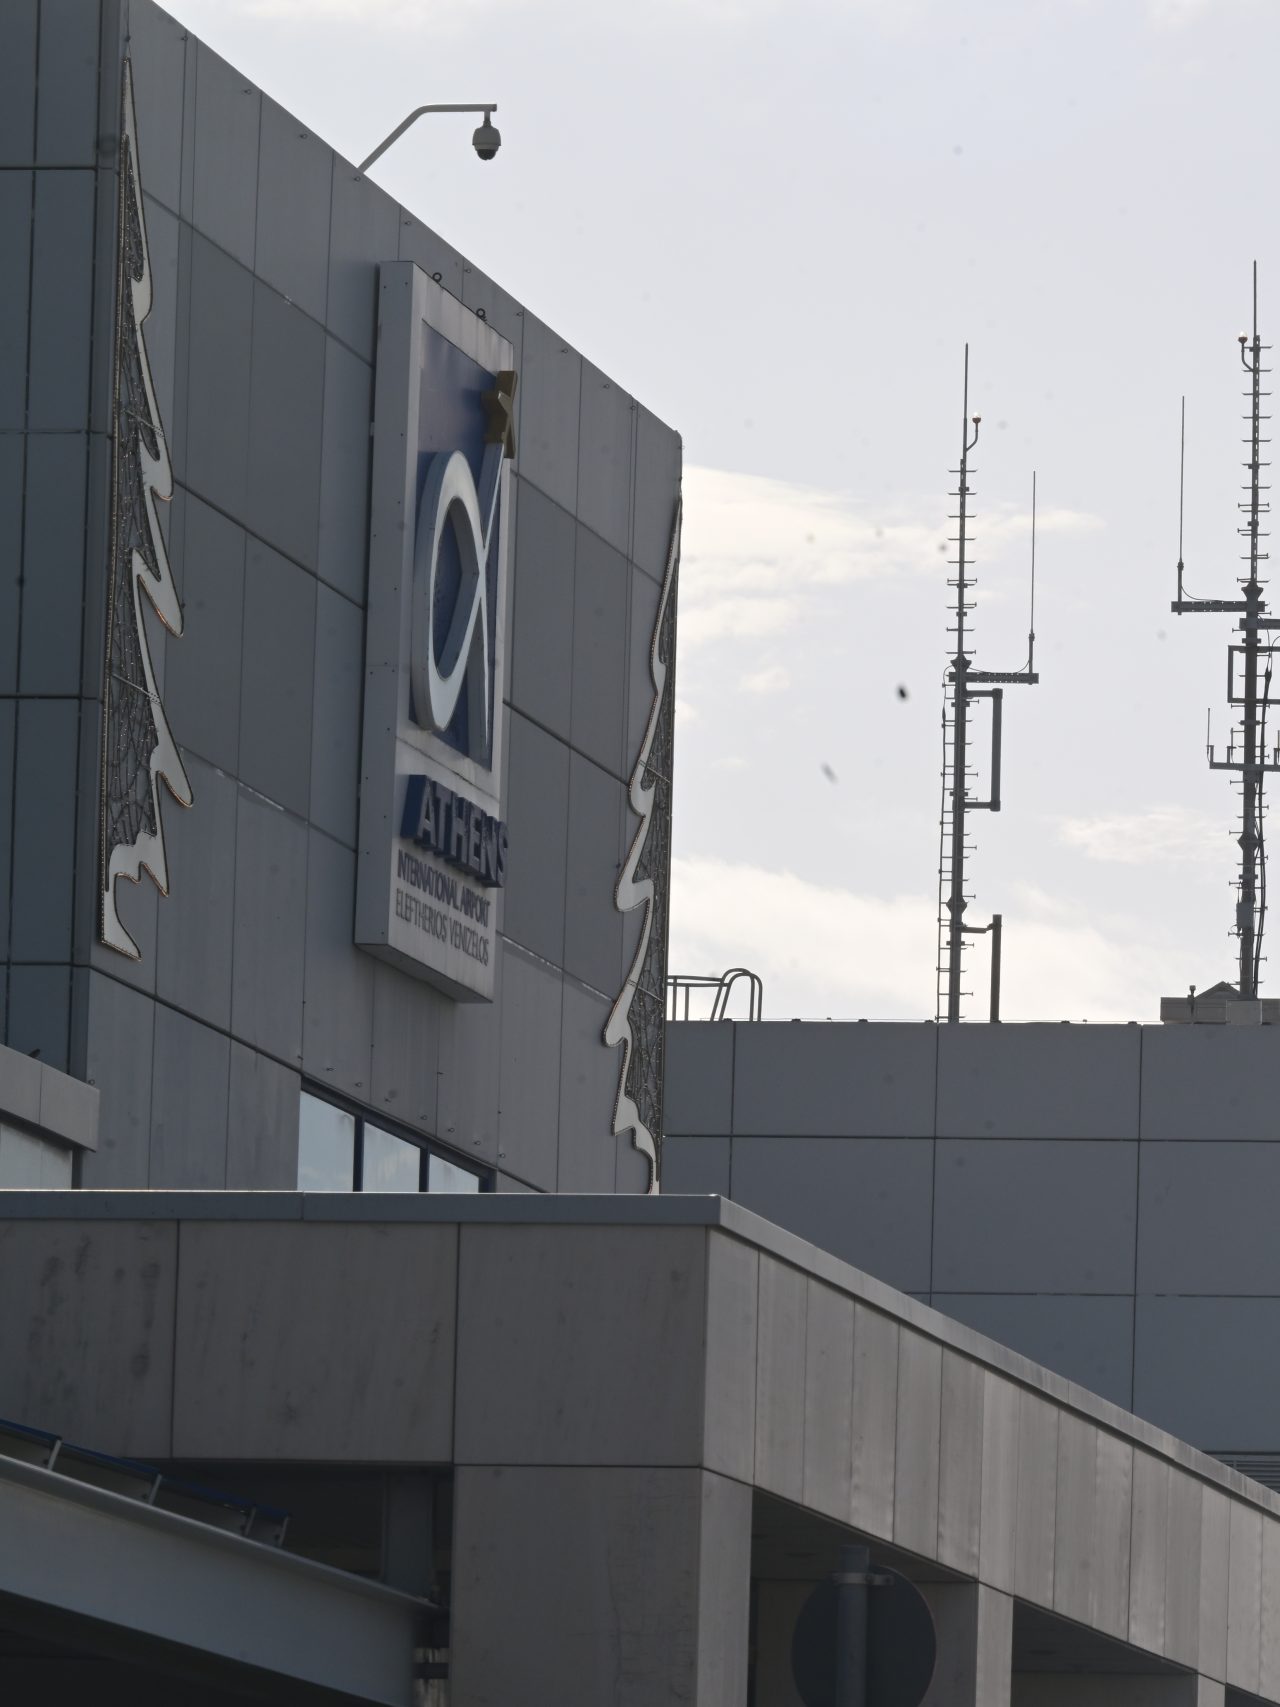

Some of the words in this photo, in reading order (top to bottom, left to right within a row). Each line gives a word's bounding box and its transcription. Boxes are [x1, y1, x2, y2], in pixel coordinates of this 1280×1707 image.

[412, 775, 509, 888] ATHENS
[395, 888, 447, 943] ELEFTHERIOS
[449, 917, 489, 966] VENIZELOS
[397, 849, 459, 910] INTERNATIONAL
[461, 885, 490, 928] AIRPORT
